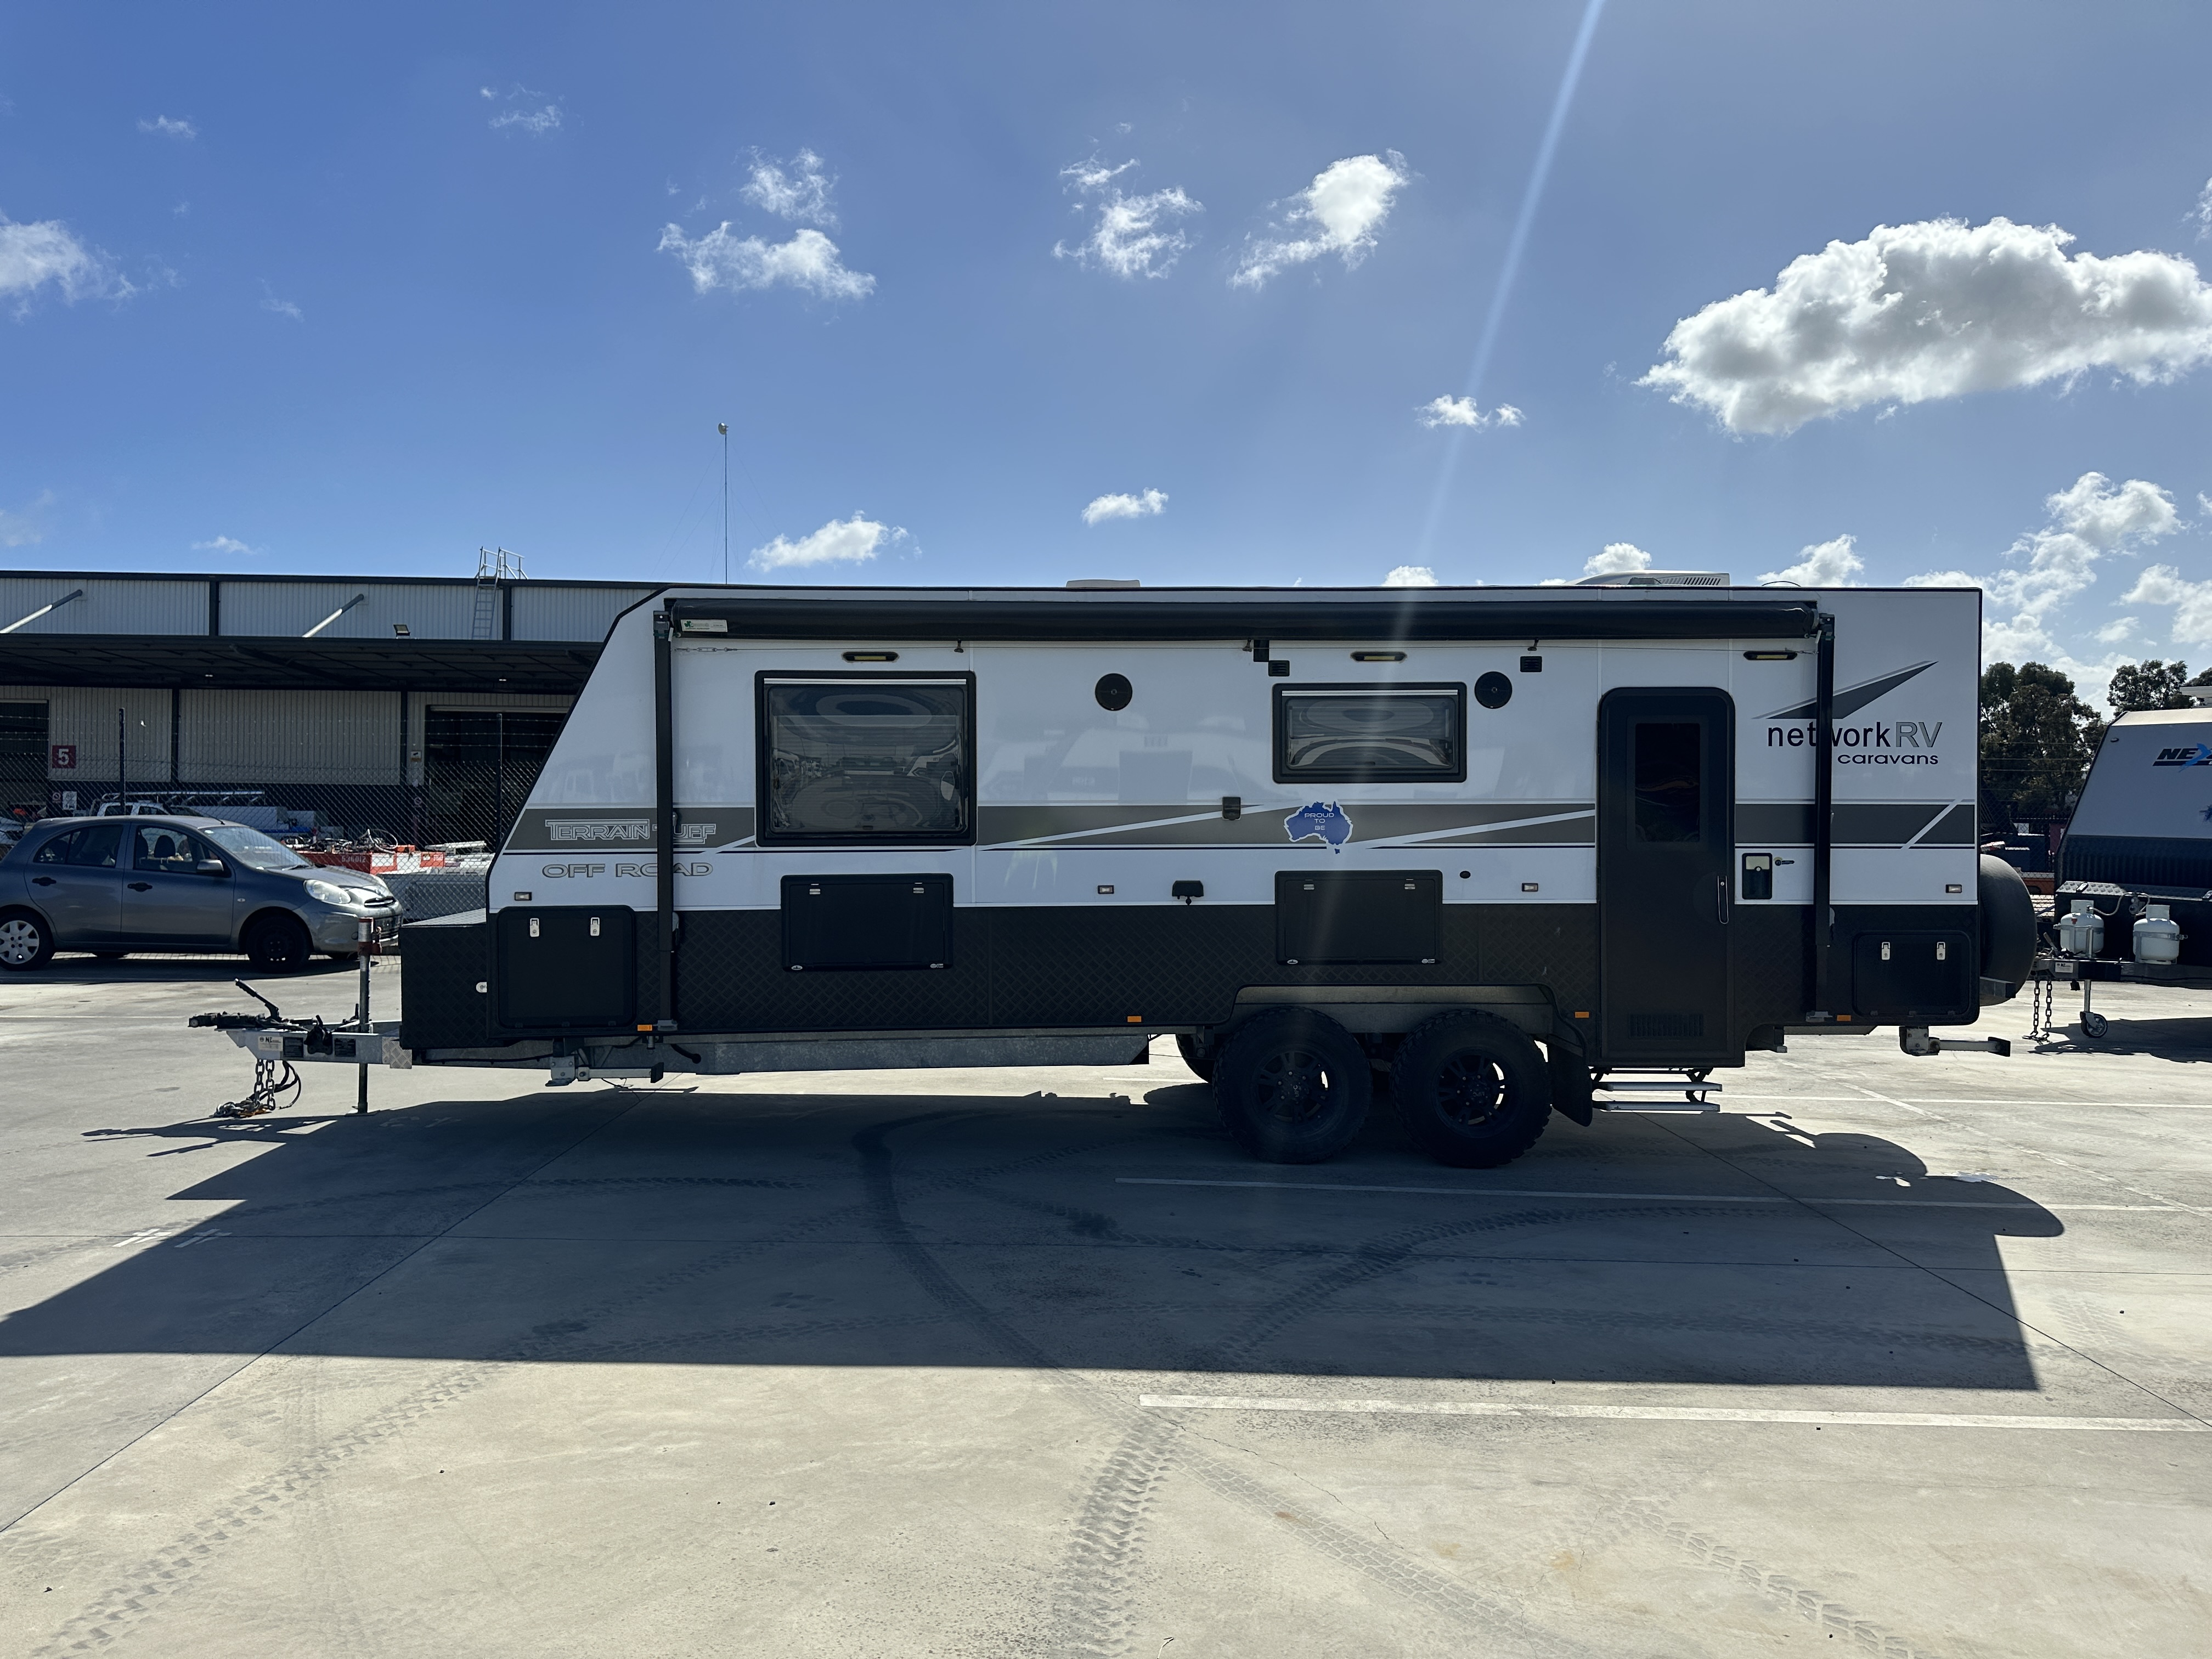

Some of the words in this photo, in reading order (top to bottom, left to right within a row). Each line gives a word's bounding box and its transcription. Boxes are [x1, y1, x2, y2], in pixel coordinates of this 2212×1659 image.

[58, 748, 69, 765] 5
[1837, 754, 1938, 764] caravans
[545, 819, 650, 840] TERRAIN
[652, 823, 716, 844] UFF
[542, 864, 606, 878] OFF
[616, 862, 713, 877] ROAD
